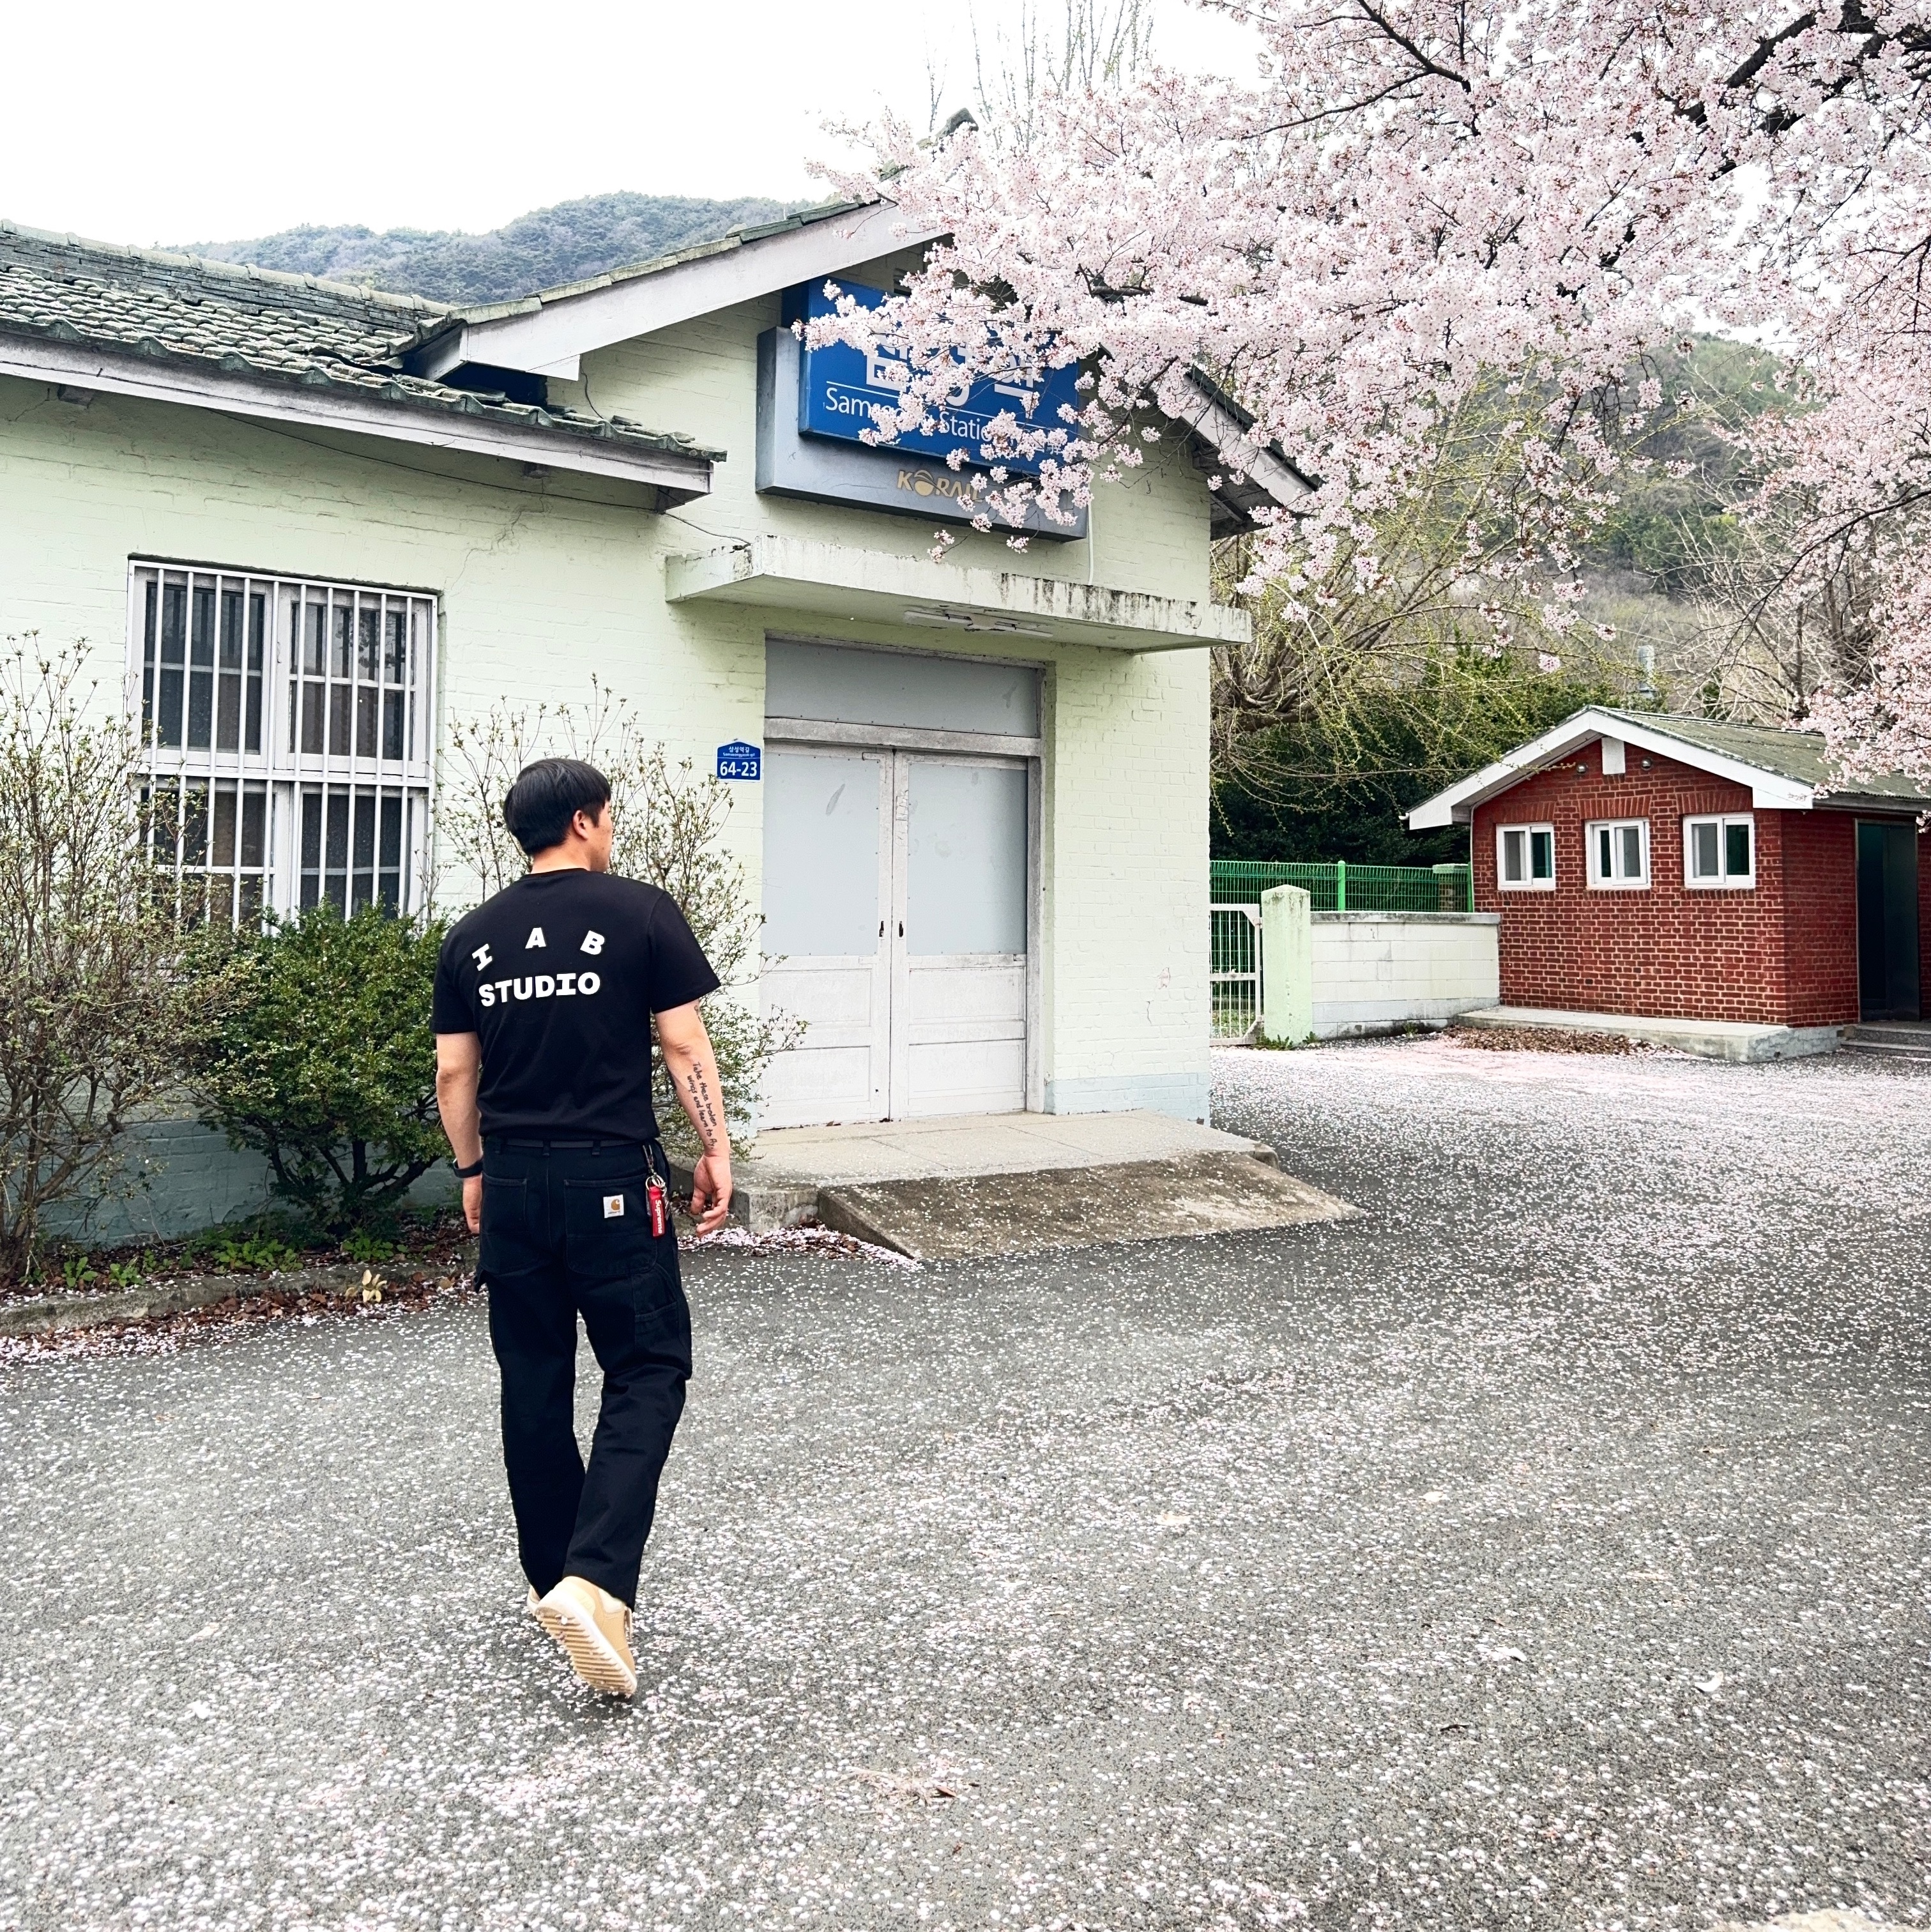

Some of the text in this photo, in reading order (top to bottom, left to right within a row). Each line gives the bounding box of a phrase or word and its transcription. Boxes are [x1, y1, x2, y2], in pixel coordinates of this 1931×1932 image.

[720, 761, 758, 777] 64-23
[478, 972, 600, 1007] STUDIO
[687, 1075, 698, 1094] wings
[694, 1097, 703, 1109] and
[699, 1110, 708, 1128] learn
[705, 1129, 714, 1137] to
[692, 1061, 717, 1127] Take these broken
